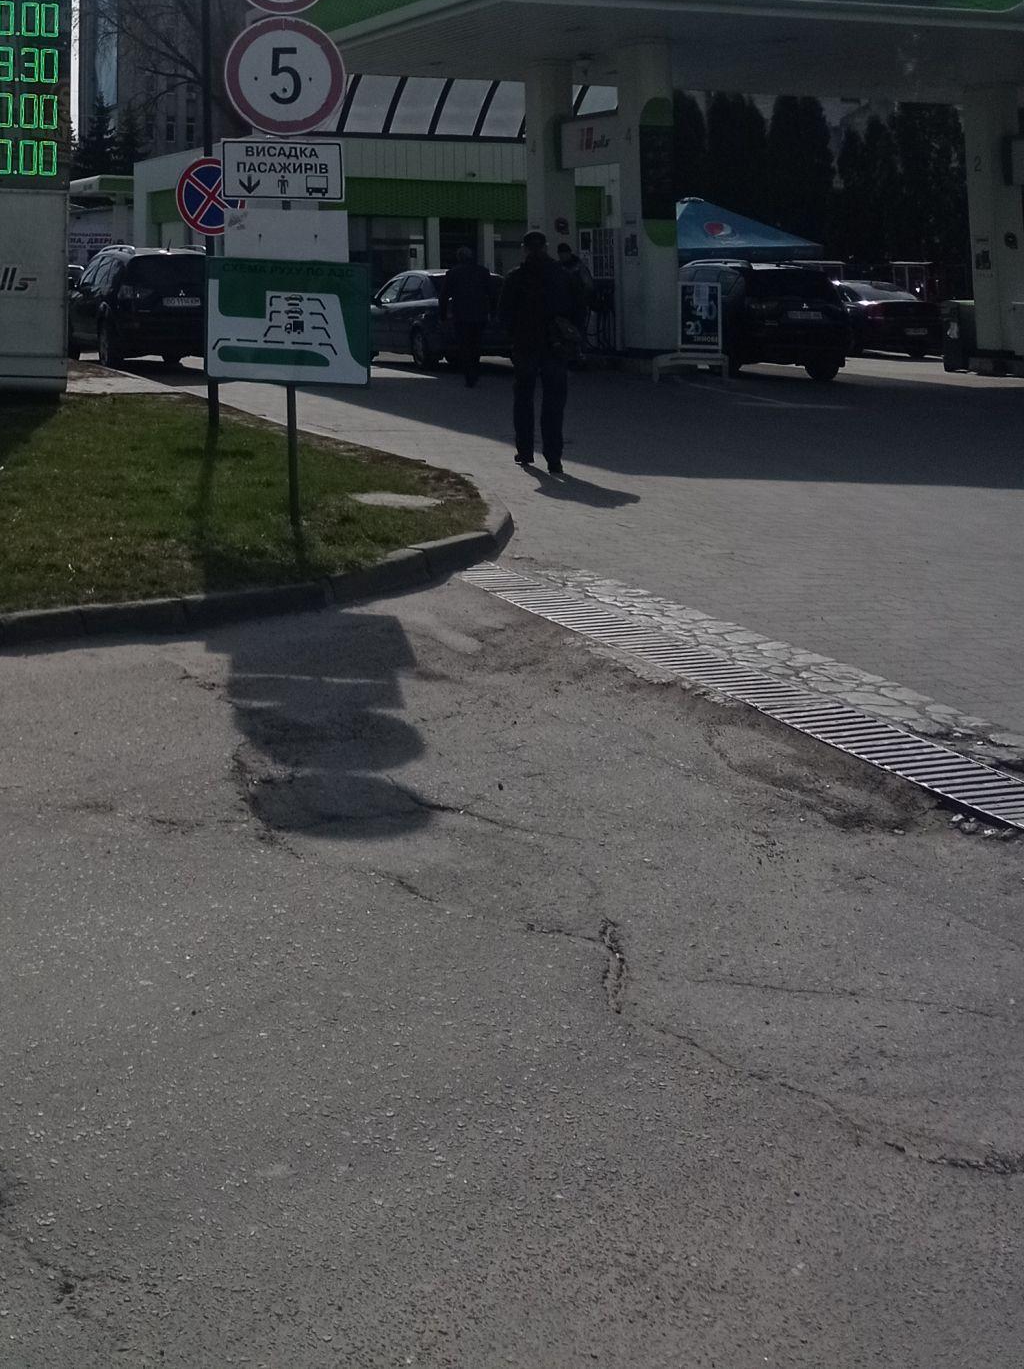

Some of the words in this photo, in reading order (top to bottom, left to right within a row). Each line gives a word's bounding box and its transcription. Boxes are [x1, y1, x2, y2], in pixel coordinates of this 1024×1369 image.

[269, 47, 302, 105] 5
[245, 145, 319, 160] ВИСАДКА
[236, 161, 329, 175] ПАСАЖИРІВ
